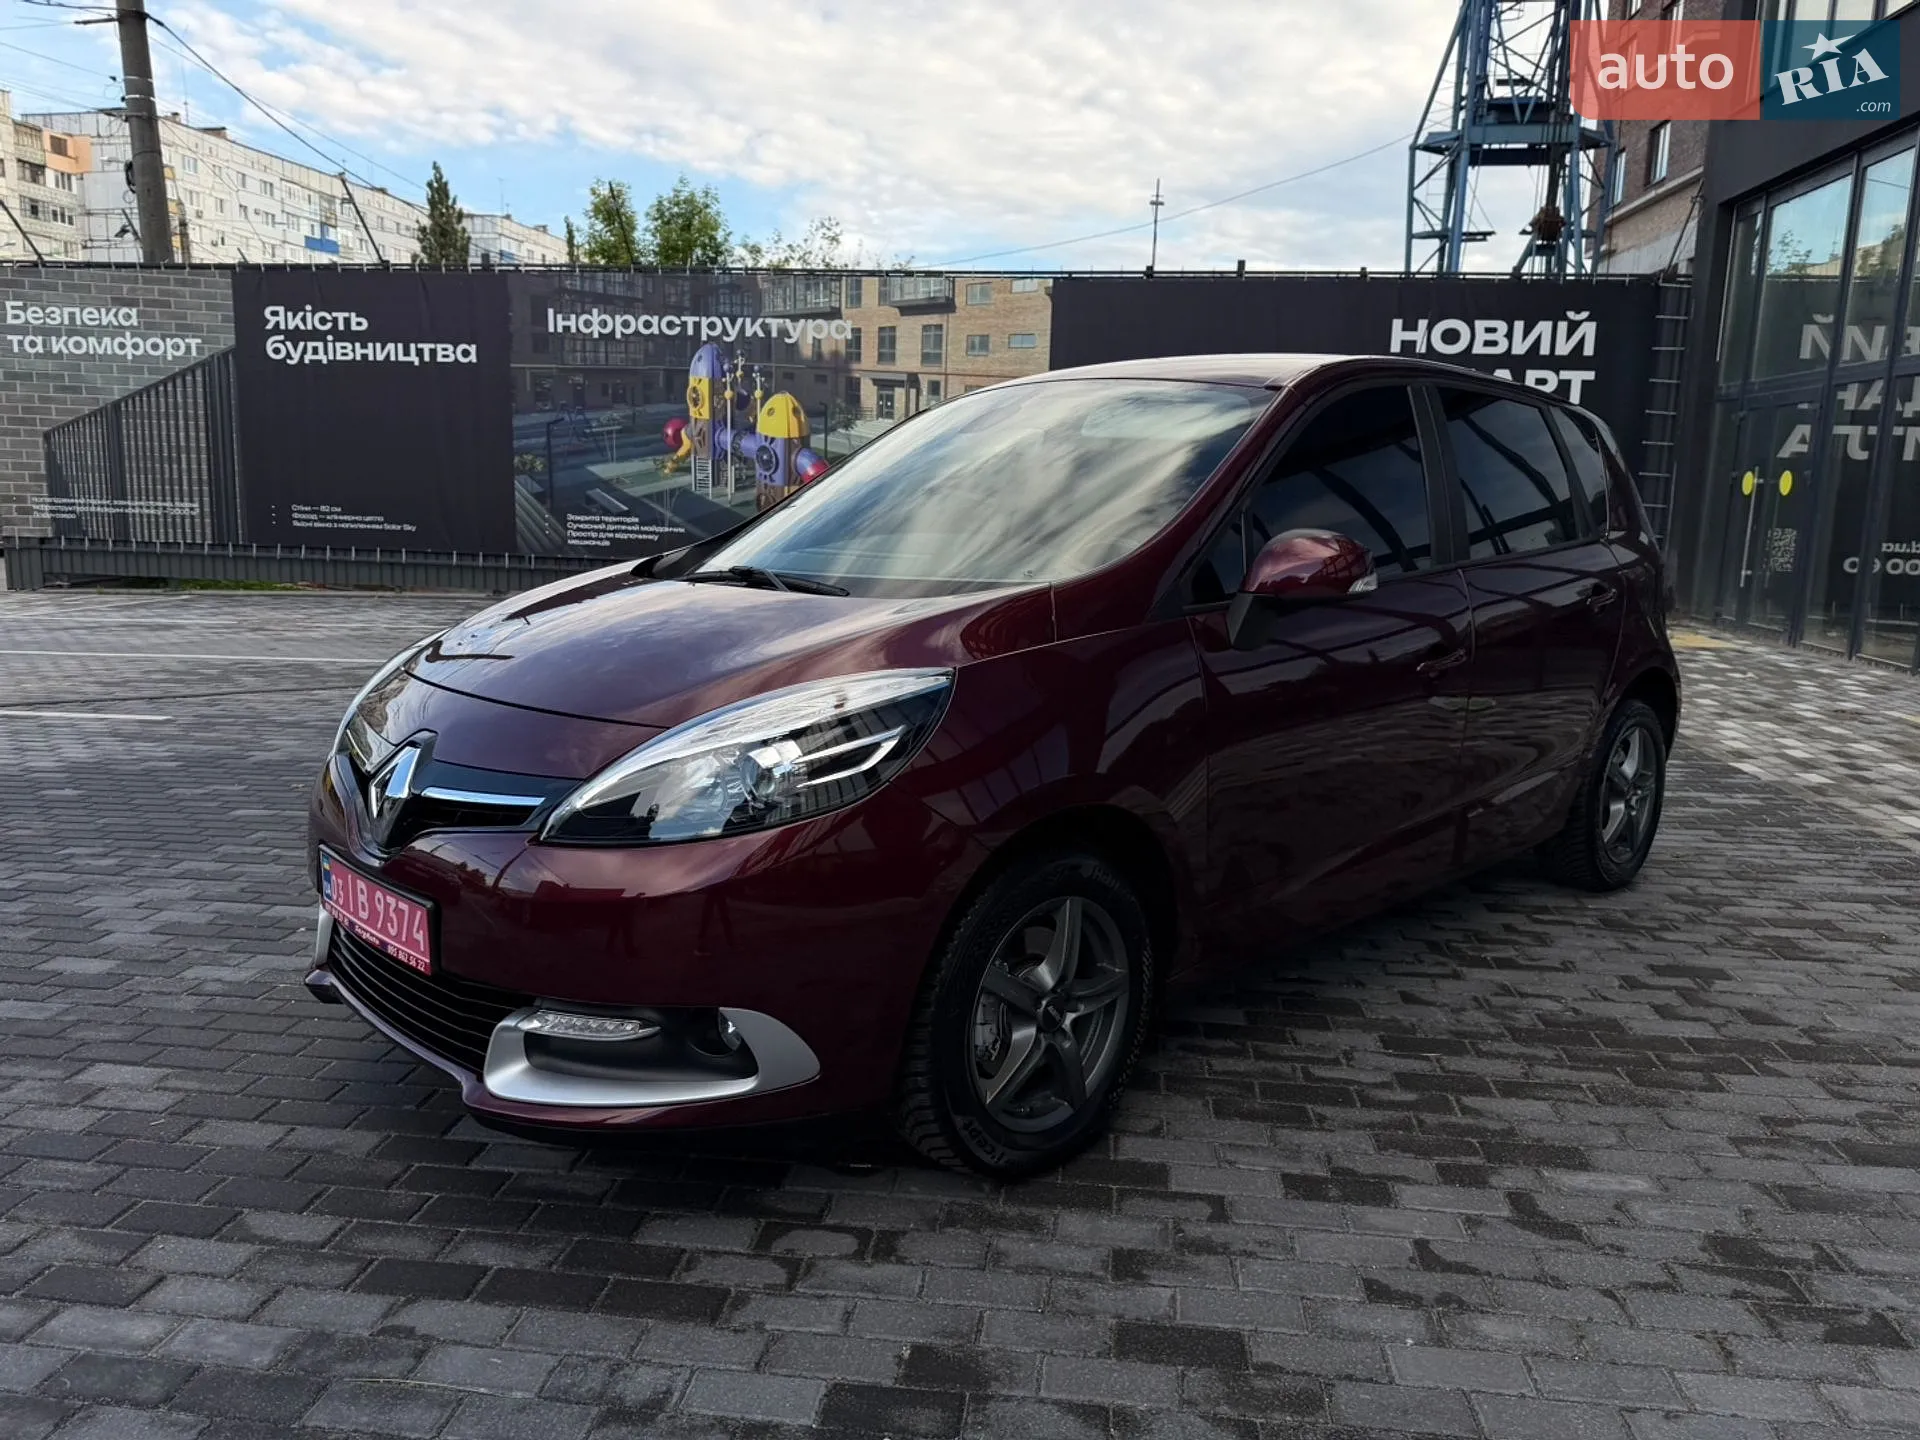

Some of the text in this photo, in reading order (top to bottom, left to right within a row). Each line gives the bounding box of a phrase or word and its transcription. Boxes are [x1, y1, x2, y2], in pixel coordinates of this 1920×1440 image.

[5, 301, 139, 329] Безпека
[262, 304, 369, 332] Якість
[546, 307, 853, 344] Інфраструктура
[6, 331, 202, 360] та комфорт
[1389, 310, 1598, 358] НОВИЙ
[264, 335, 478, 366] будівництва
[566, 513, 640, 523] Закрита територія
[567, 521, 606, 530] Сучасний
[640, 525, 686, 533] майданчик
[567, 530, 598, 538] Простір
[614, 533, 660, 542] відпочинку
[331, 874, 344, 906] 03
[374, 889, 426, 953] 9374
